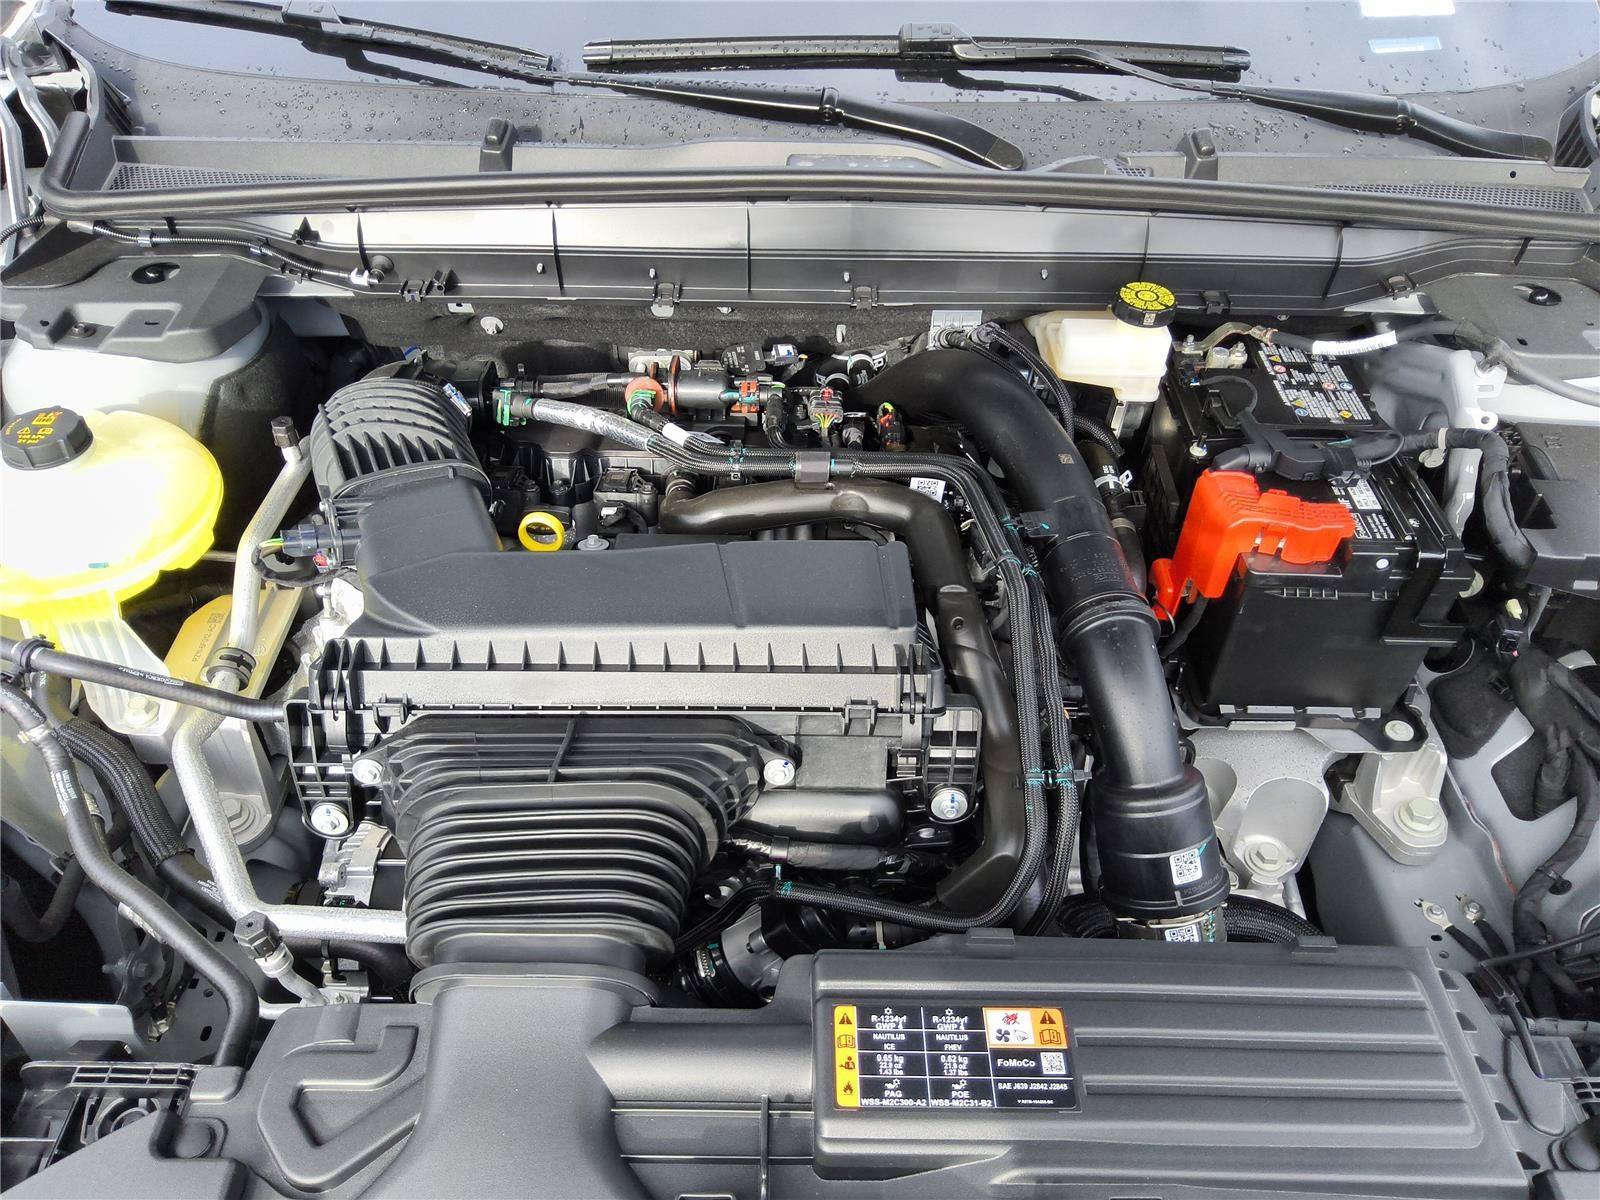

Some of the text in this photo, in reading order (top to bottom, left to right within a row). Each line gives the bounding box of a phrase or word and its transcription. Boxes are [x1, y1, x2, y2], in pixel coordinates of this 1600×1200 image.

[893, 1054, 904, 1064] kg
[957, 1055, 969, 1065] kg
[997, 1058, 1036, 1067] FoMoCo
[1049, 1083, 1068, 1091] J2845
[884, 1090, 902, 1098] PAG
[861, 1098, 927, 1106] WSS-M2C300-A2
[930, 1099, 993, 1107] WSS-M2C31-B2
